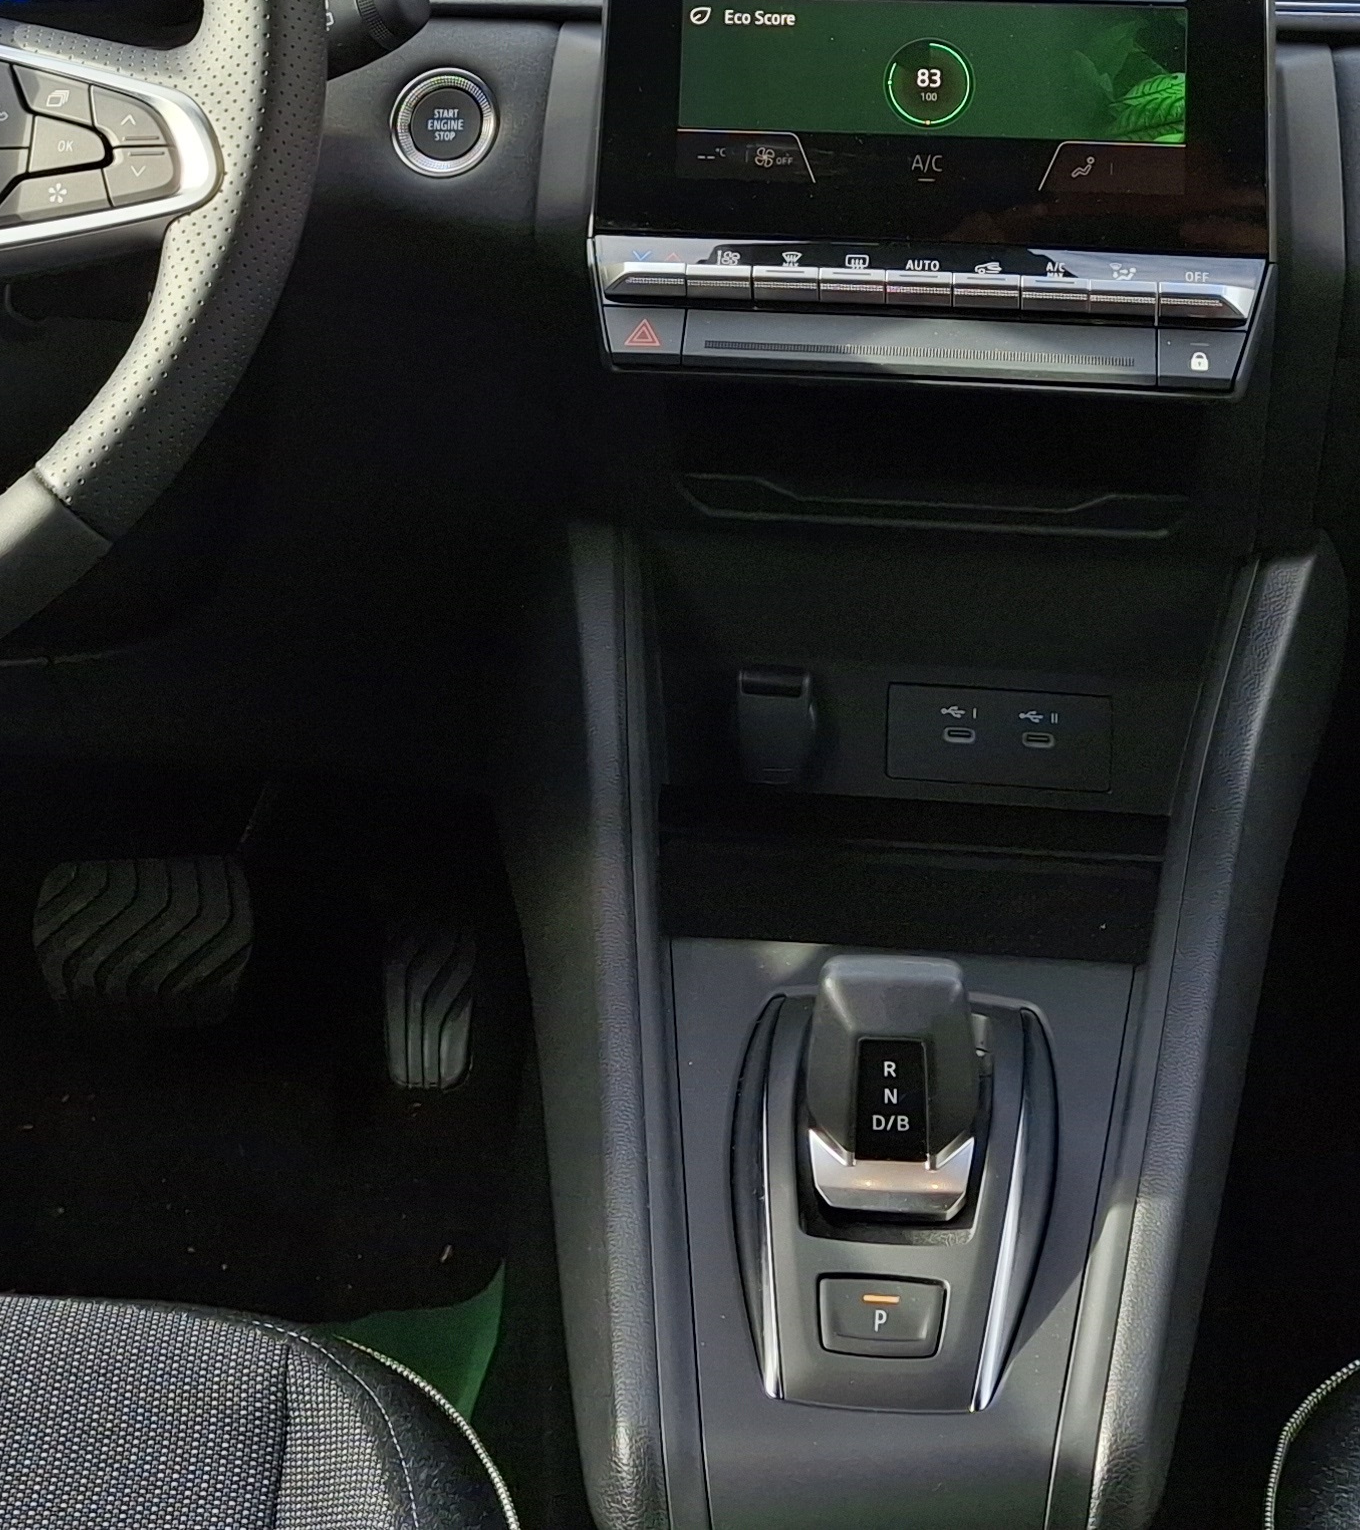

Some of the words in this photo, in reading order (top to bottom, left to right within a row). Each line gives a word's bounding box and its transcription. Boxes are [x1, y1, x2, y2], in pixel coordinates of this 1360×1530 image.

[724, 10, 750, 26] Eco
[754, 10, 796, 27] Score
[916, 68, 941, 88] 83
[920, 92, 938, 102] 100
[433, 108, 459, 118] START
[427, 119, 464, 131] ENGINE
[434, 131, 456, 141] STOP
[57, 140, 74, 153] OK
[775, 156, 794, 166] OFF
[911, 154, 943, 173] A/C
[905, 259, 940, 272] AUTO
[1045, 261, 1066, 272] A/C
[1185, 271, 1210, 283] OFF
[883, 1060, 897, 1078] R
[884, 1088, 898, 1104] N
[872, 1114, 910, 1132] D/B
[874, 1309, 888, 1332] P
